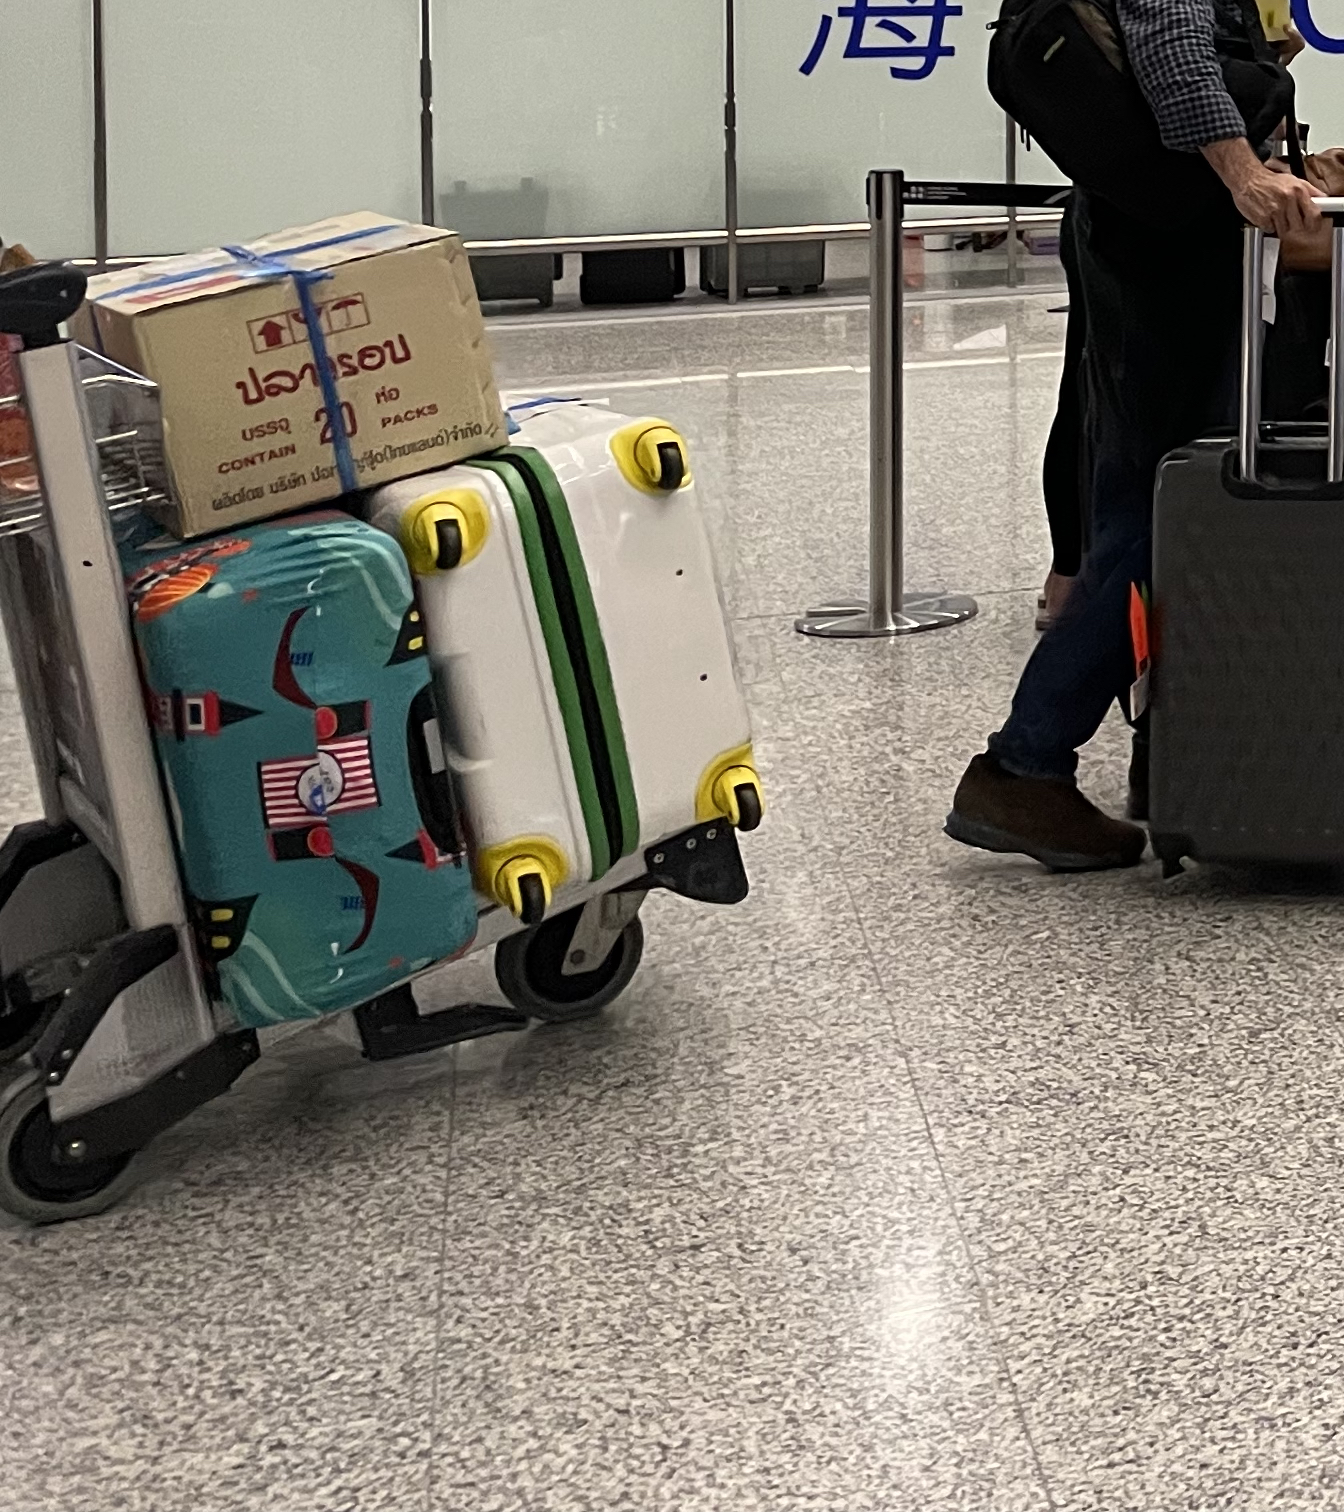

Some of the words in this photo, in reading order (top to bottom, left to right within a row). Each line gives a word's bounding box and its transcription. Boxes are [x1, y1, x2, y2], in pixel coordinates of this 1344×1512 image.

[314, 401, 358, 445] 20
[381, 403, 439, 428] PACKS
[218, 443, 296, 474] CONTAIN
